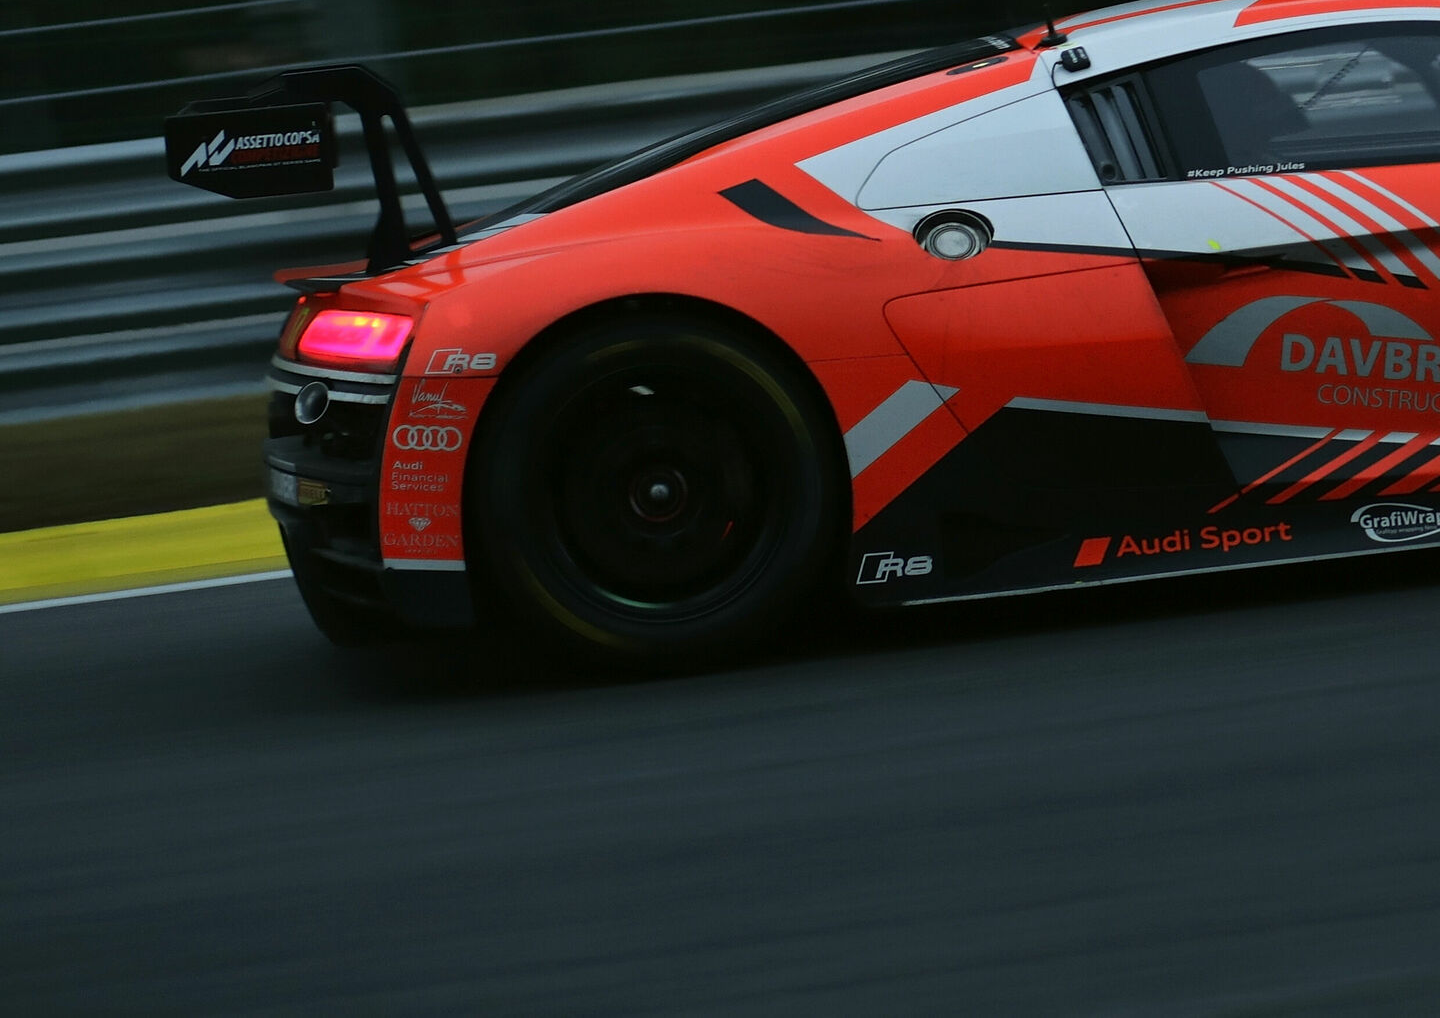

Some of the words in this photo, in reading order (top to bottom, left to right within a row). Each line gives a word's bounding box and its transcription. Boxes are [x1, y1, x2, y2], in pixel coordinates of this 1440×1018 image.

[235, 133, 283, 150] ASSETTO
[1187, 168, 1224, 178] #Keep
[1227, 163, 1274, 175] Pushing
[1276, 161, 1306, 172] Jules
[392, 461, 424, 470] Audi
[391, 471, 449, 483] Financial
[391, 481, 445, 493] Services
[385, 501, 461, 517] HATTON
[384, 533, 459, 549] GARDEN
[1115, 528, 1192, 558] Audi
[1200, 520, 1294, 553] Sport
